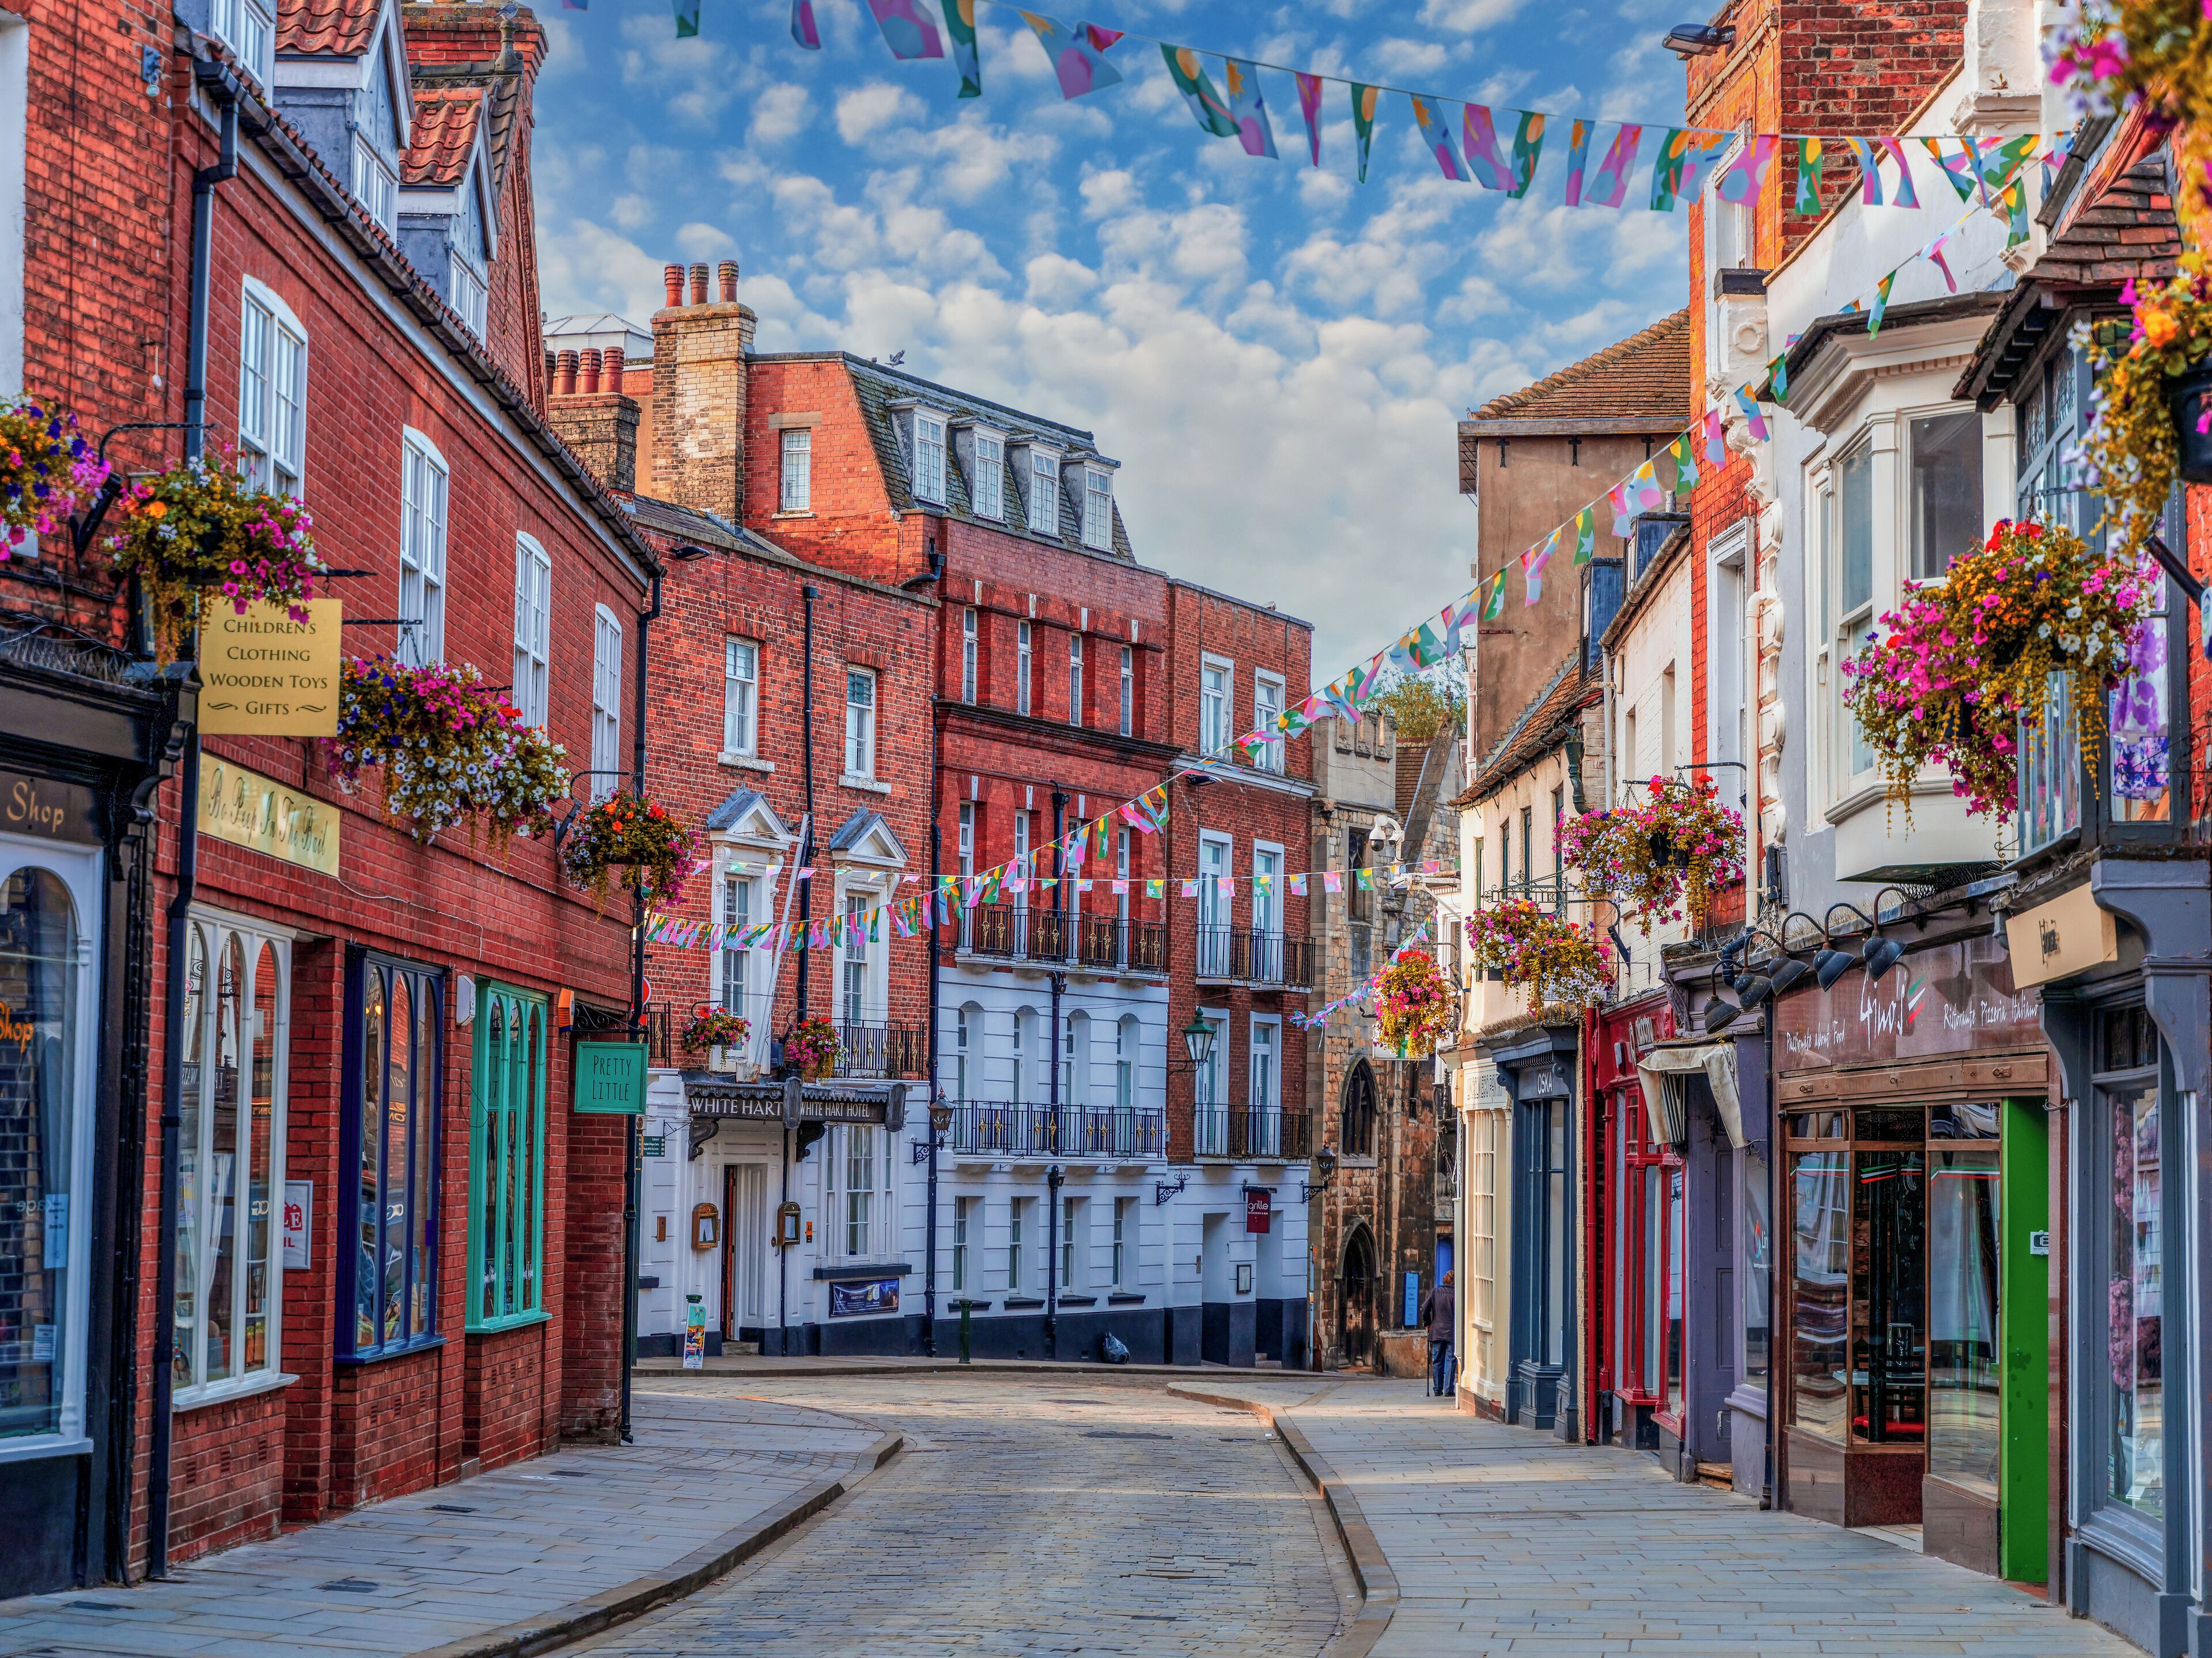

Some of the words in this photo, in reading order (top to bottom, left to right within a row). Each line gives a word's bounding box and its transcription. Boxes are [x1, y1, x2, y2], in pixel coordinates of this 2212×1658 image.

[224, 619, 316, 635] CHILDREN'S
[227, 646, 310, 662] CLOTHING
[210, 673, 283, 688] WOODEN
[290, 675, 328, 689] TOYS
[245, 701, 290, 715] GIFTS
[6, 781, 65, 833] Shop
[208, 768, 227, 820] Bo
[230, 777, 257, 844] Peep
[260, 791, 276, 838] In
[279, 796, 298, 847] The
[1860, 966, 1907, 1051] Gino's
[1944, 1000, 1976, 1031] Ristorante
[1980, 999, 2007, 1027] Pizzeria
[2012, 988, 2039, 1023] Italiano
[1786, 1027, 1812, 1054] Passionate
[1815, 1022, 1830, 1050] about
[1833, 1018, 1846, 1046] Food
[593, 1055, 632, 1076] PRETTY
[592, 1079, 630, 1101] LITTLE
[1537, 1071, 1552, 1094] OSKA
[691, 1097, 738, 1114] WHITE
[742, 1099, 784, 1116] HART
[800, 1101, 823, 1116] WHITE
[825, 1102, 844, 1117] HART
[847, 1102, 870, 1117] HOTEL
[1248, 1200, 1268, 1212] grille
